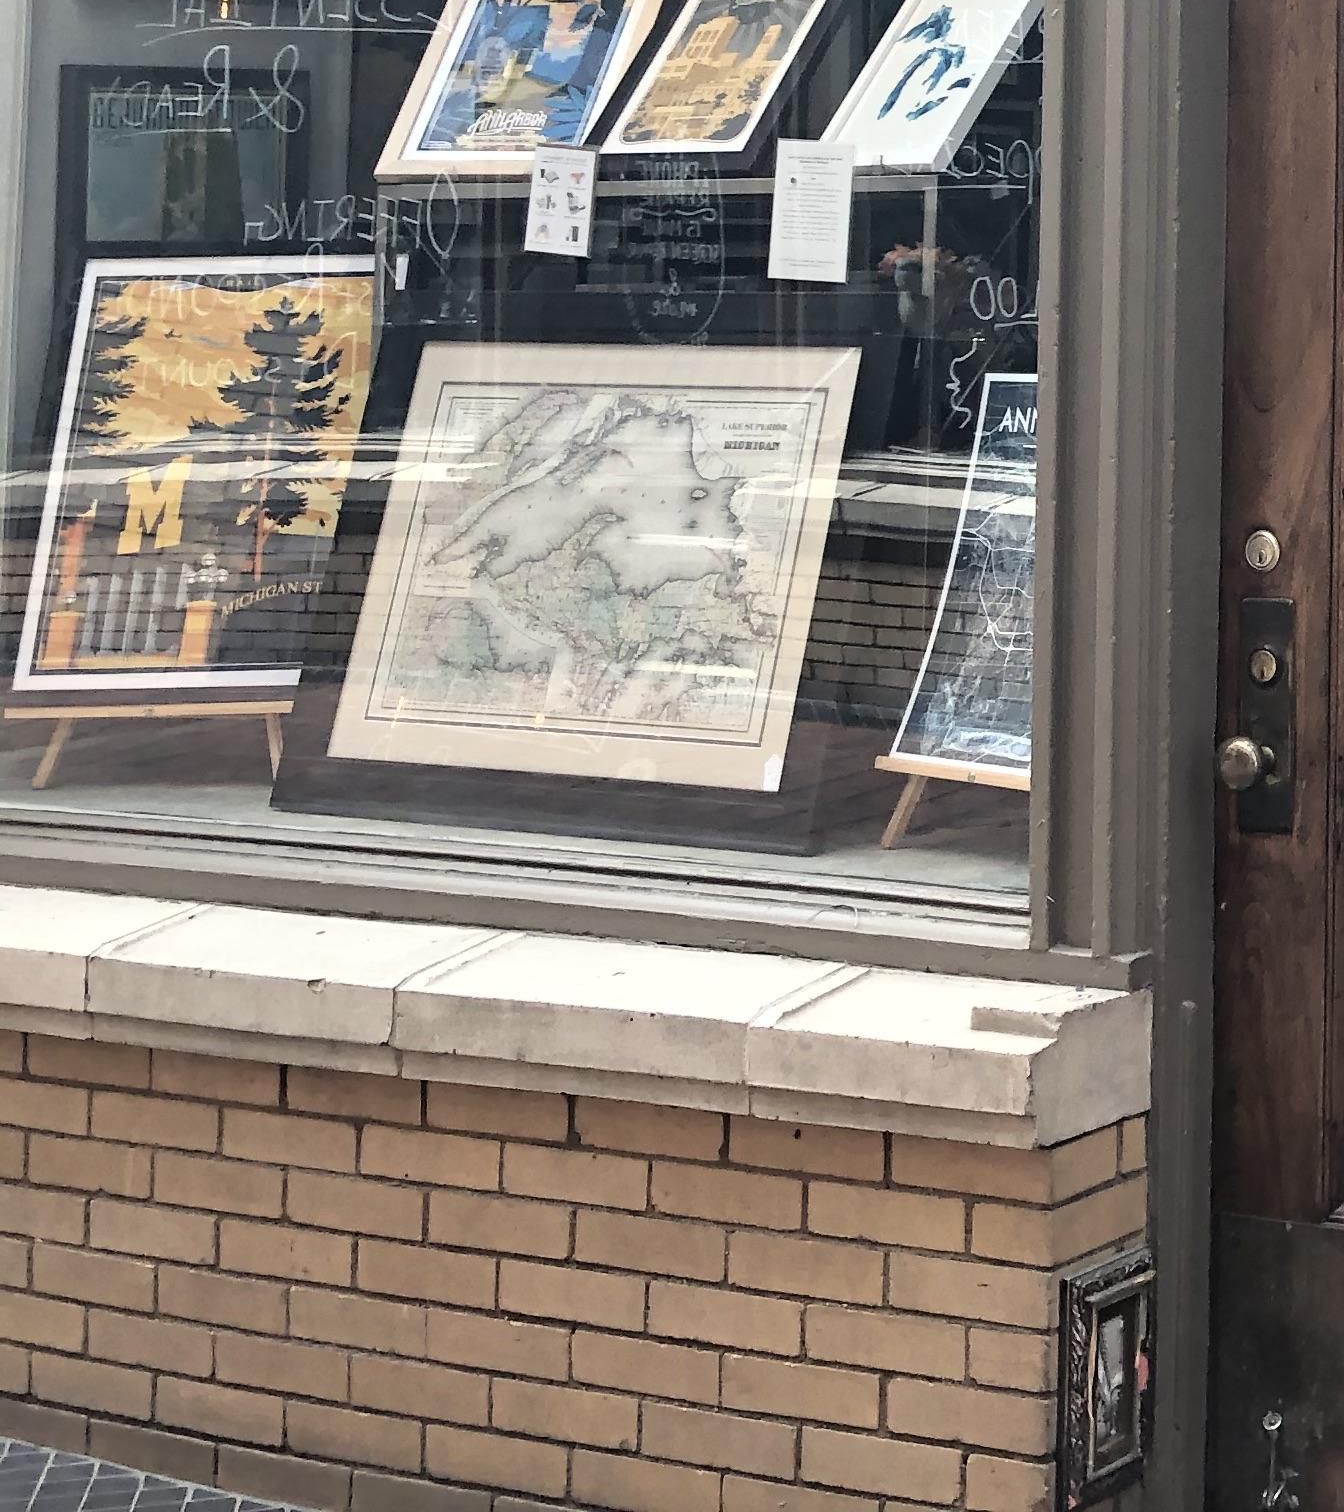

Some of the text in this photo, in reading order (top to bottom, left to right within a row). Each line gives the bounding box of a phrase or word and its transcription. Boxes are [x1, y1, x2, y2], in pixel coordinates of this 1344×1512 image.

[723, 440, 780, 451] MICHIGAN
[221, 579, 324, 618] MICHIGAN ST
